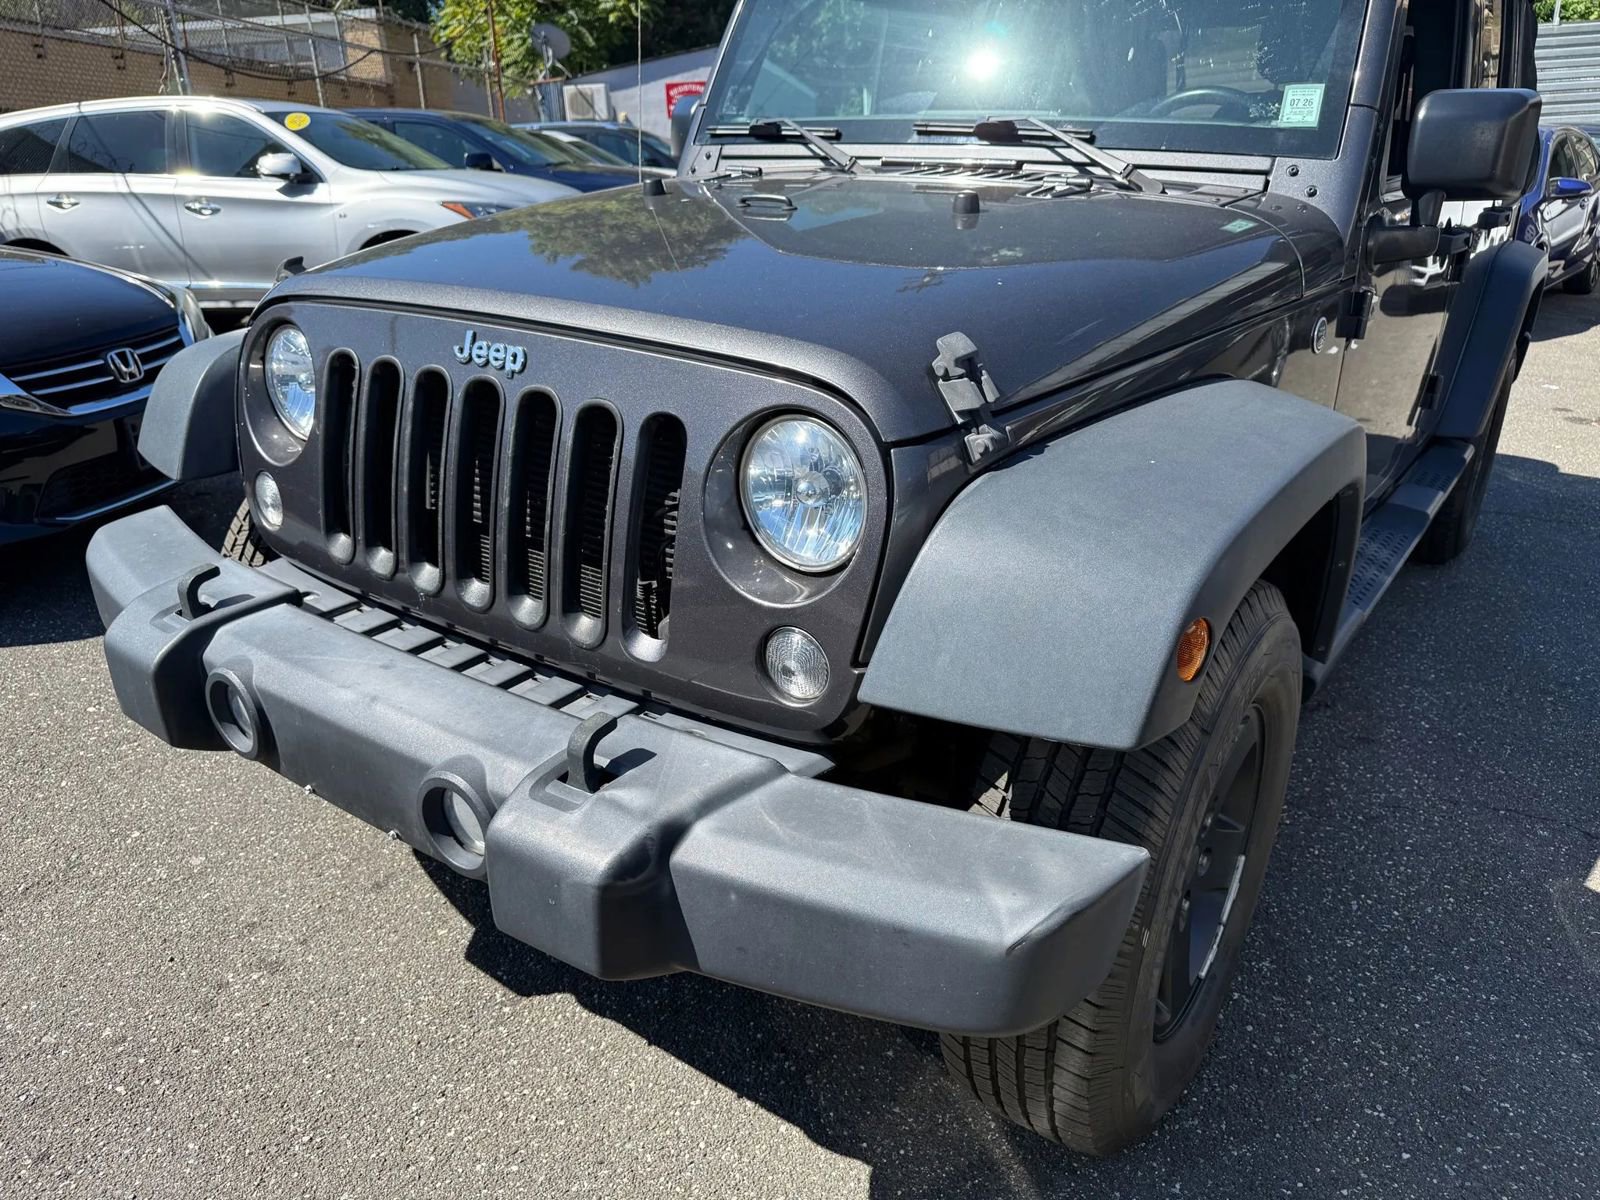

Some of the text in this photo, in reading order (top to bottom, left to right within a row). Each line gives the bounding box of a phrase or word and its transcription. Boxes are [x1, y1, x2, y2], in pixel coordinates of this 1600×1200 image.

[1289, 98, 1314, 107] 07 26
[453, 330, 527, 379] Jeep
